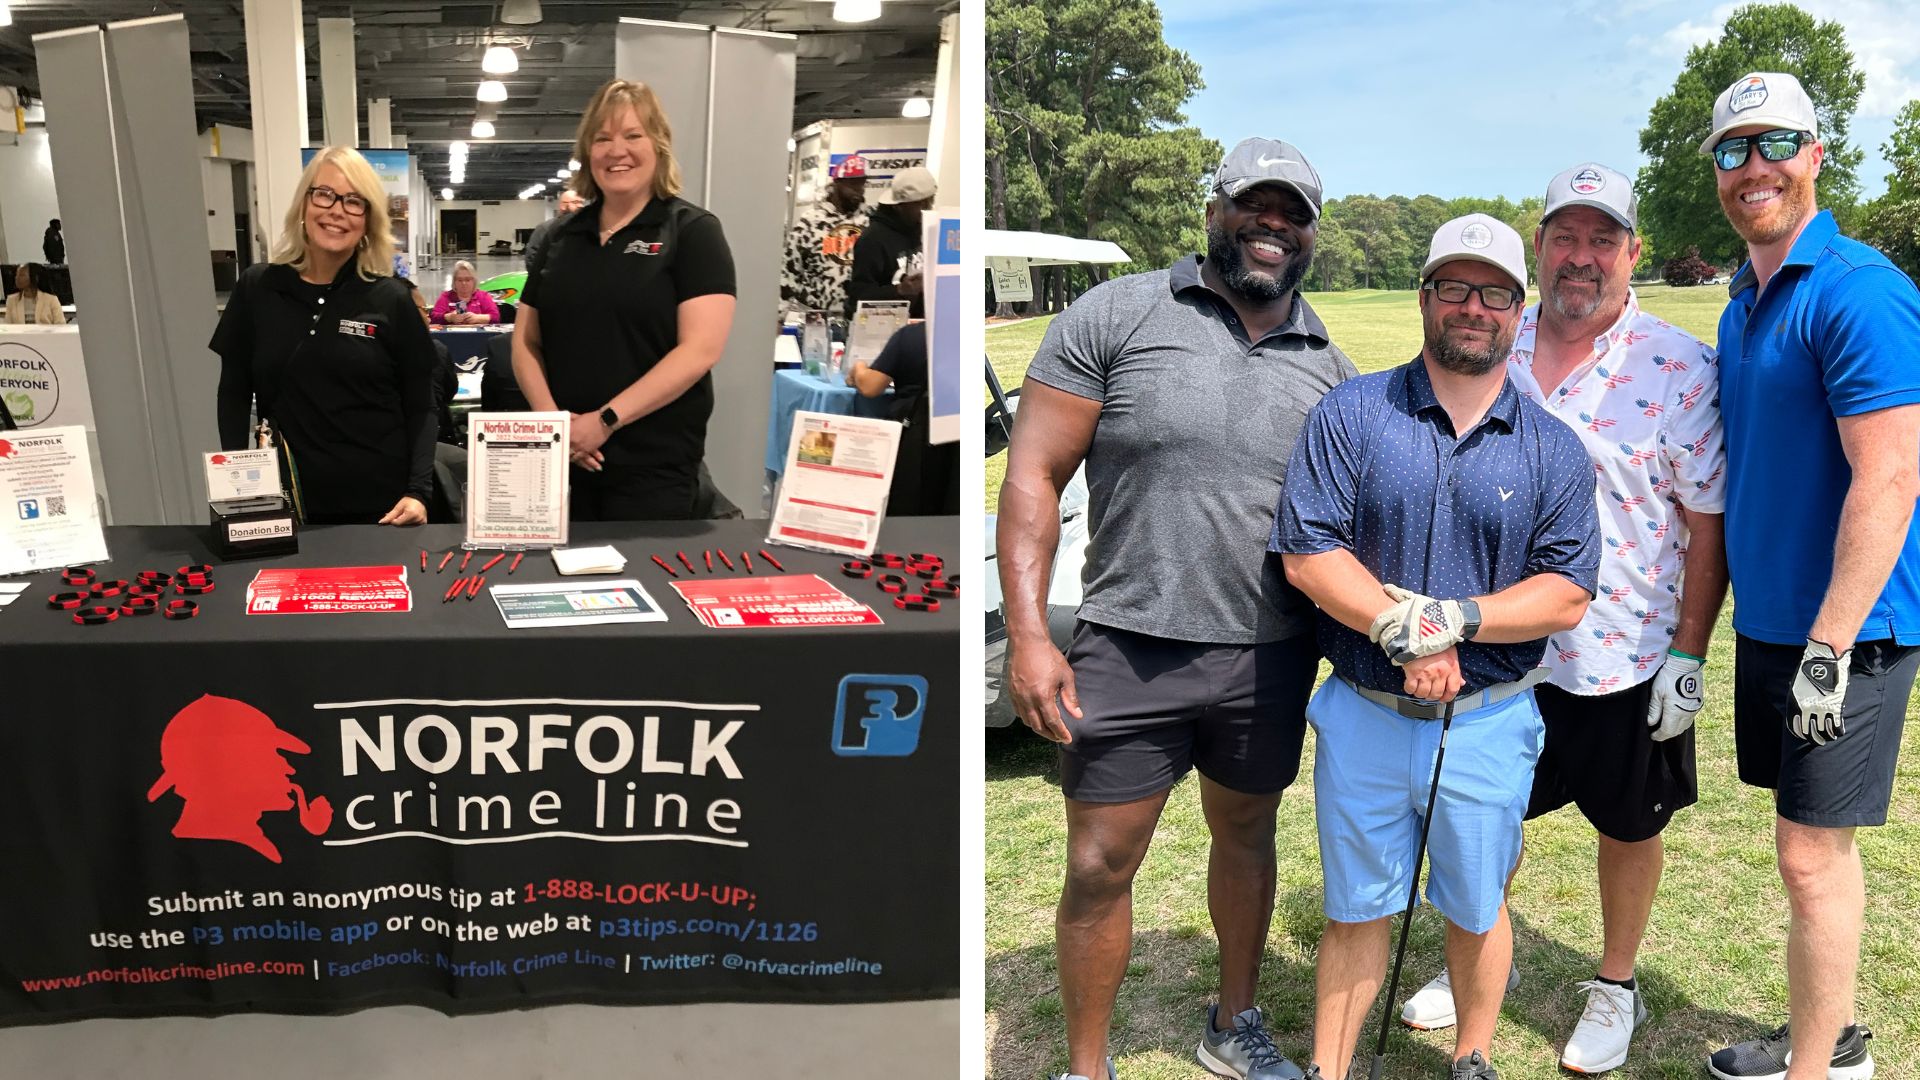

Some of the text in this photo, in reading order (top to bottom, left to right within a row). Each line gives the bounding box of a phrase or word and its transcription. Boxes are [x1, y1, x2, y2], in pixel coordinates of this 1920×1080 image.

[0, 359, 47, 371] RFOLK
[0, 378, 49, 390] ERYONE
[484, 421, 553, 434] Norfolk Crime Line
[18, 438, 63, 447] NORFOLK
[230, 525, 291, 537] Donation Box
[340, 714, 745, 780] NORFOLK
[345, 779, 742, 834] crime line
[148, 879, 757, 916] Submit an anonymous tip at 1-888-LOCK-U-UP;
[90, 913, 818, 949] use the P3 mobile app or on the web at p3tips.com/1126
[22, 949, 883, 992] www.norfolkcrimeline.com Facebook: Norfolk Crime Line Twitter: @nfvacrimeline
